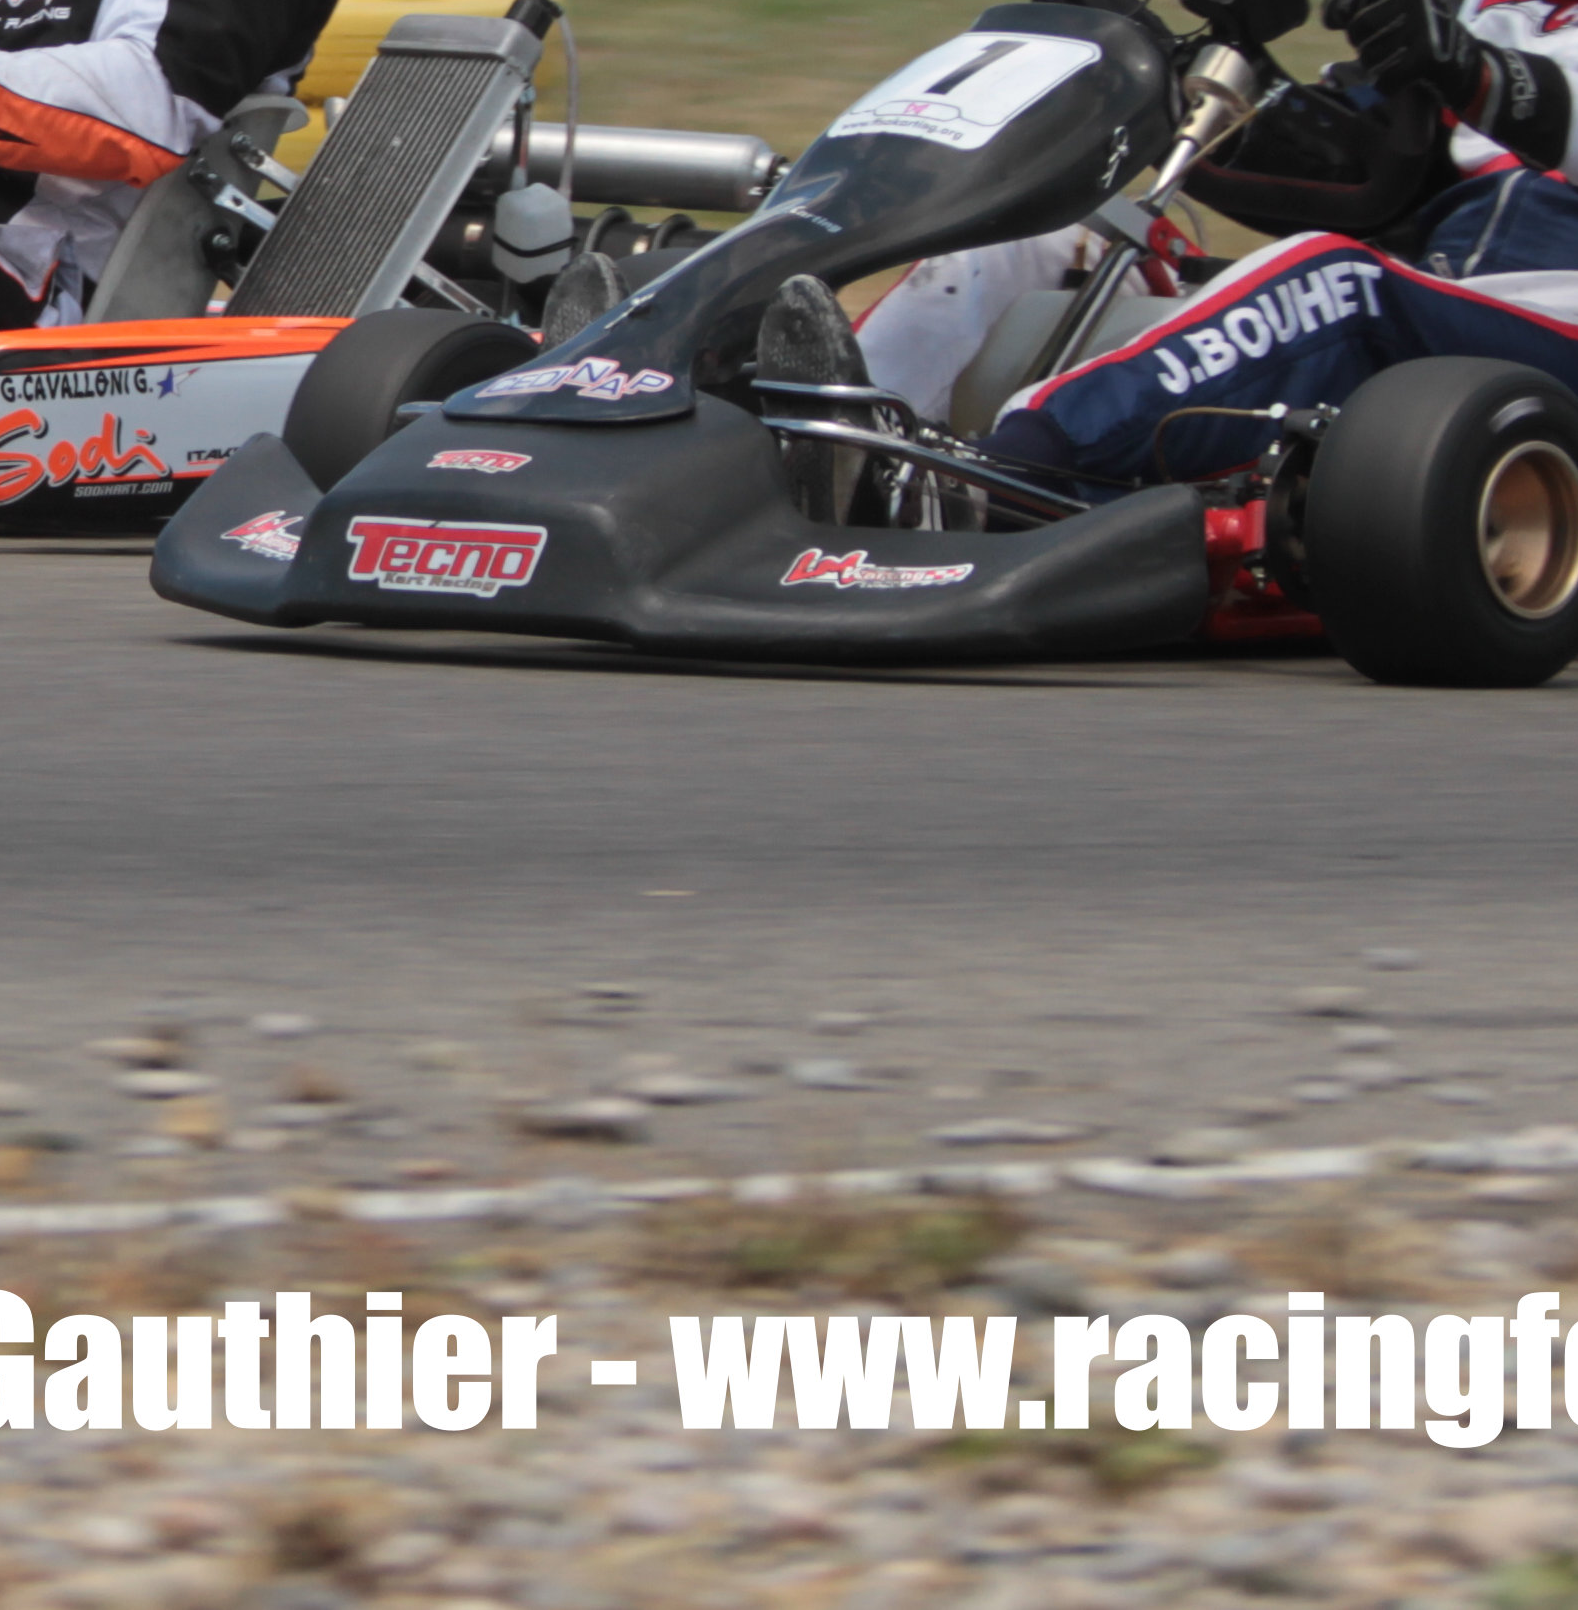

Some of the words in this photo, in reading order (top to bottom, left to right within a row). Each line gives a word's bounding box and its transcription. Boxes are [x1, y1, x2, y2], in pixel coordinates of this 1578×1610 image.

[922, 39, 1030, 96] 1
[1153, 260, 1383, 395] J.BOUHET
[351, 521, 543, 581] Tecno
[382, 571, 425, 587] Kart
[428, 574, 498, 592] Racing
